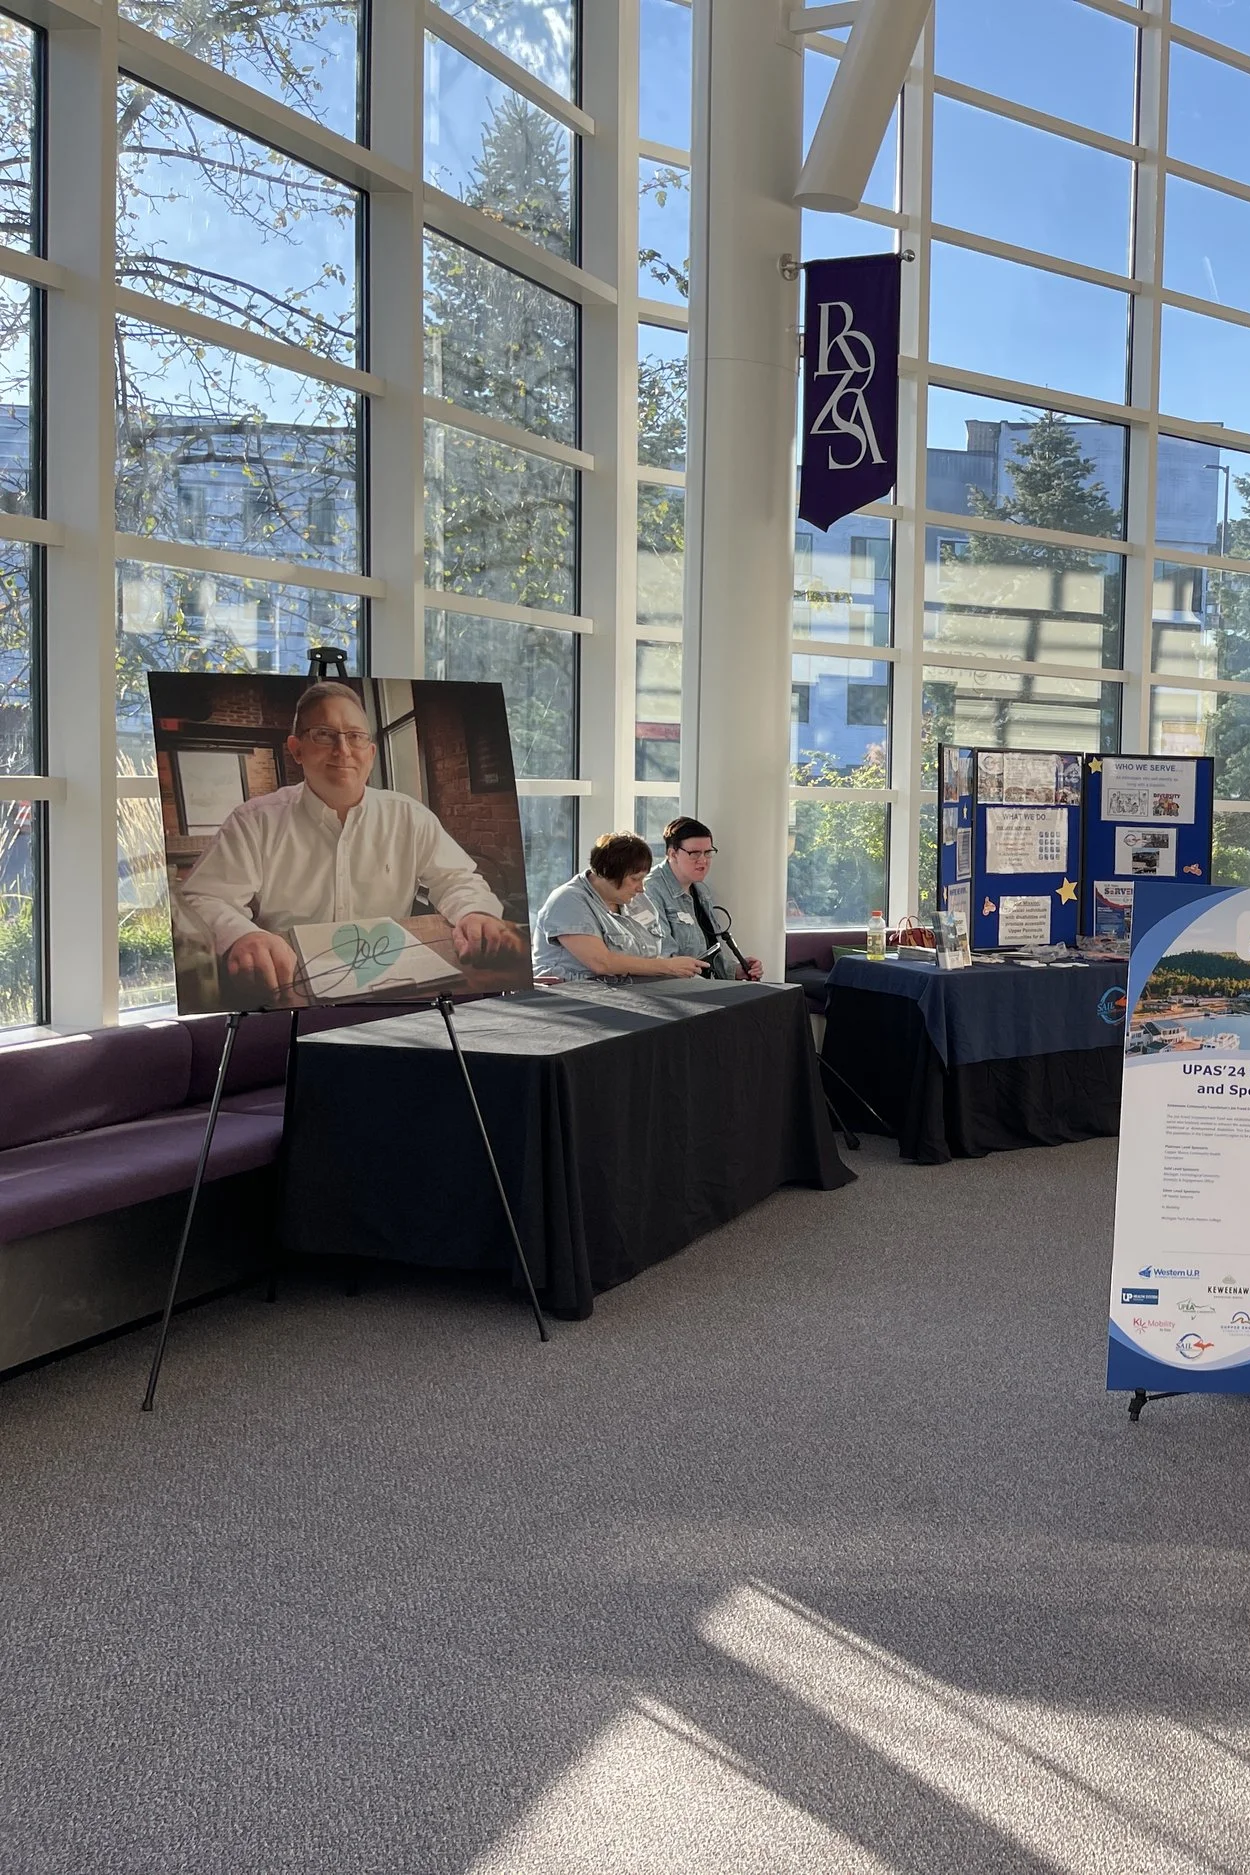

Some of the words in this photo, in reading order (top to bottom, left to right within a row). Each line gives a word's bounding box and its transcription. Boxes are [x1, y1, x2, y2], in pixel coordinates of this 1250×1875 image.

[1197, 1084, 1224, 1095] and
[1153, 1268, 1185, 1276] Western
[1207, 1286, 1249, 1295] KEWEENAW
[1147, 1319, 1175, 1328] Mobility
